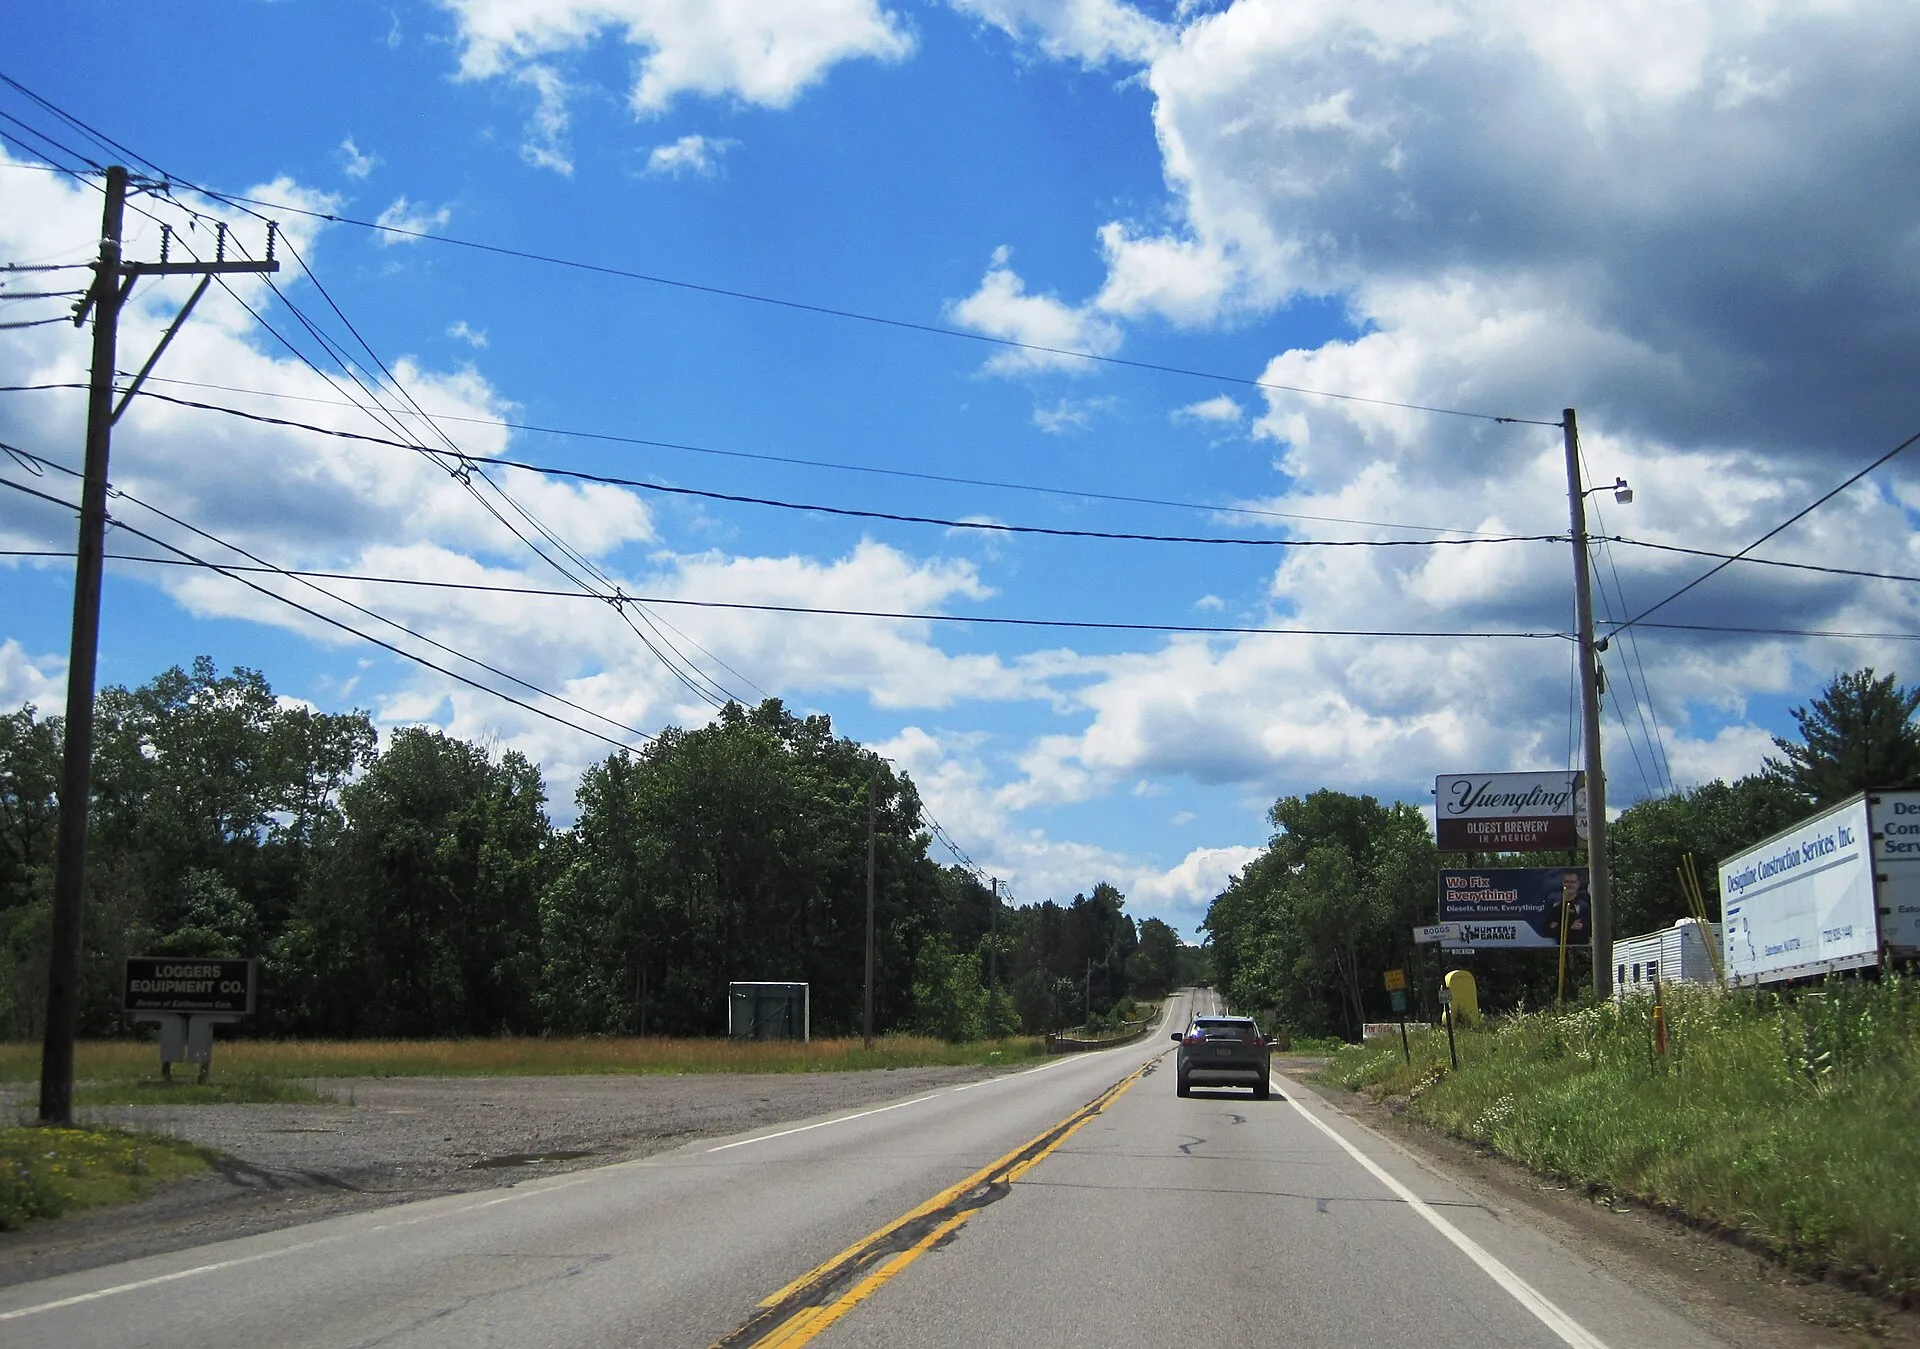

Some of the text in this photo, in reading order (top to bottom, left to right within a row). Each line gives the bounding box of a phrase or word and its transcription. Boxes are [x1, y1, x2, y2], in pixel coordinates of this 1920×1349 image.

[1446, 780, 1576, 815] Yuengling
[1467, 820, 1549, 834] OLDEST BREWERY
[1479, 833, 1538, 843] IN AMERICA
[1727, 825, 1855, 894] Designline Construction Services, Inc.
[1446, 876, 1490, 888] We Fix
[1446, 889, 1518, 903] Everything!
[1446, 904, 1545, 914] Diesels, Euros, Everything!
[1423, 926, 1450, 935] BOGGS
[1474, 926, 1517, 934] HUNTER'S
[1480, 932, 1517, 940] GARAGE
[155, 965, 222, 978] LOGGERS
[130, 979, 245, 993] EQUIPMENT CO.
[163, 999, 172, 1007] of
